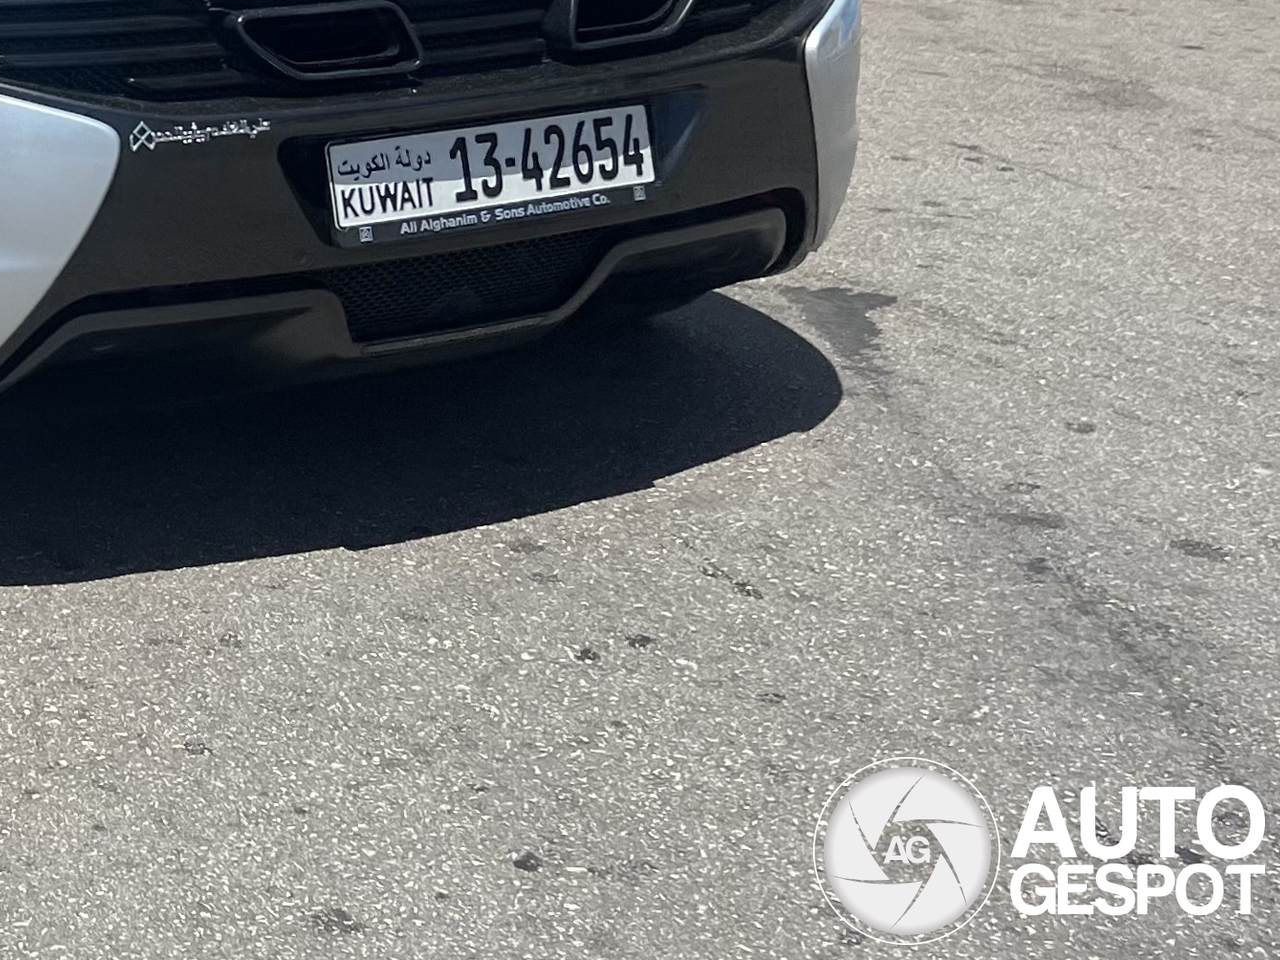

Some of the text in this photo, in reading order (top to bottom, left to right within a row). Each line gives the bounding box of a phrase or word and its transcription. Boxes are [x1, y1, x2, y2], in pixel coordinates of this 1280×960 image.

[337, 145, 431, 181] دولة الكويت
[449, 113, 644, 203] 13-42654
[340, 177, 434, 219] KUWAIT
[400, 193, 611, 235] Ali Alghanim & Sons Automotive Co.
